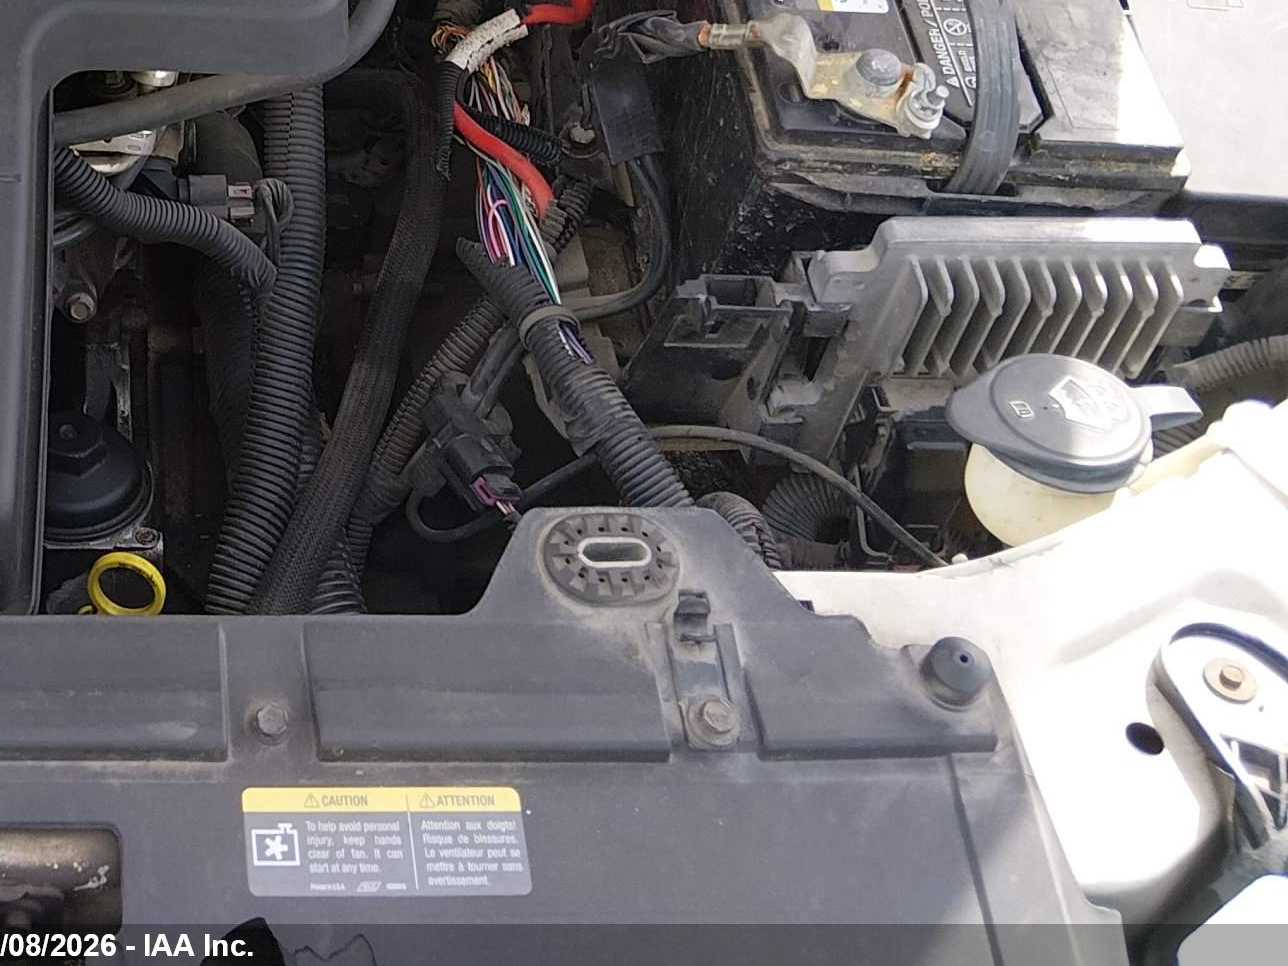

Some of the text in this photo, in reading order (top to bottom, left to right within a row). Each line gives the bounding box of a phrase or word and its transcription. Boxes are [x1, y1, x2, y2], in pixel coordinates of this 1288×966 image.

[928, 29, 954, 74] DANGER
[321, 795, 368, 806] CAUTION
[437, 795, 495, 806] ATTENTION
[318, 821, 336, 833] help
[363, 821, 400, 833] personal
